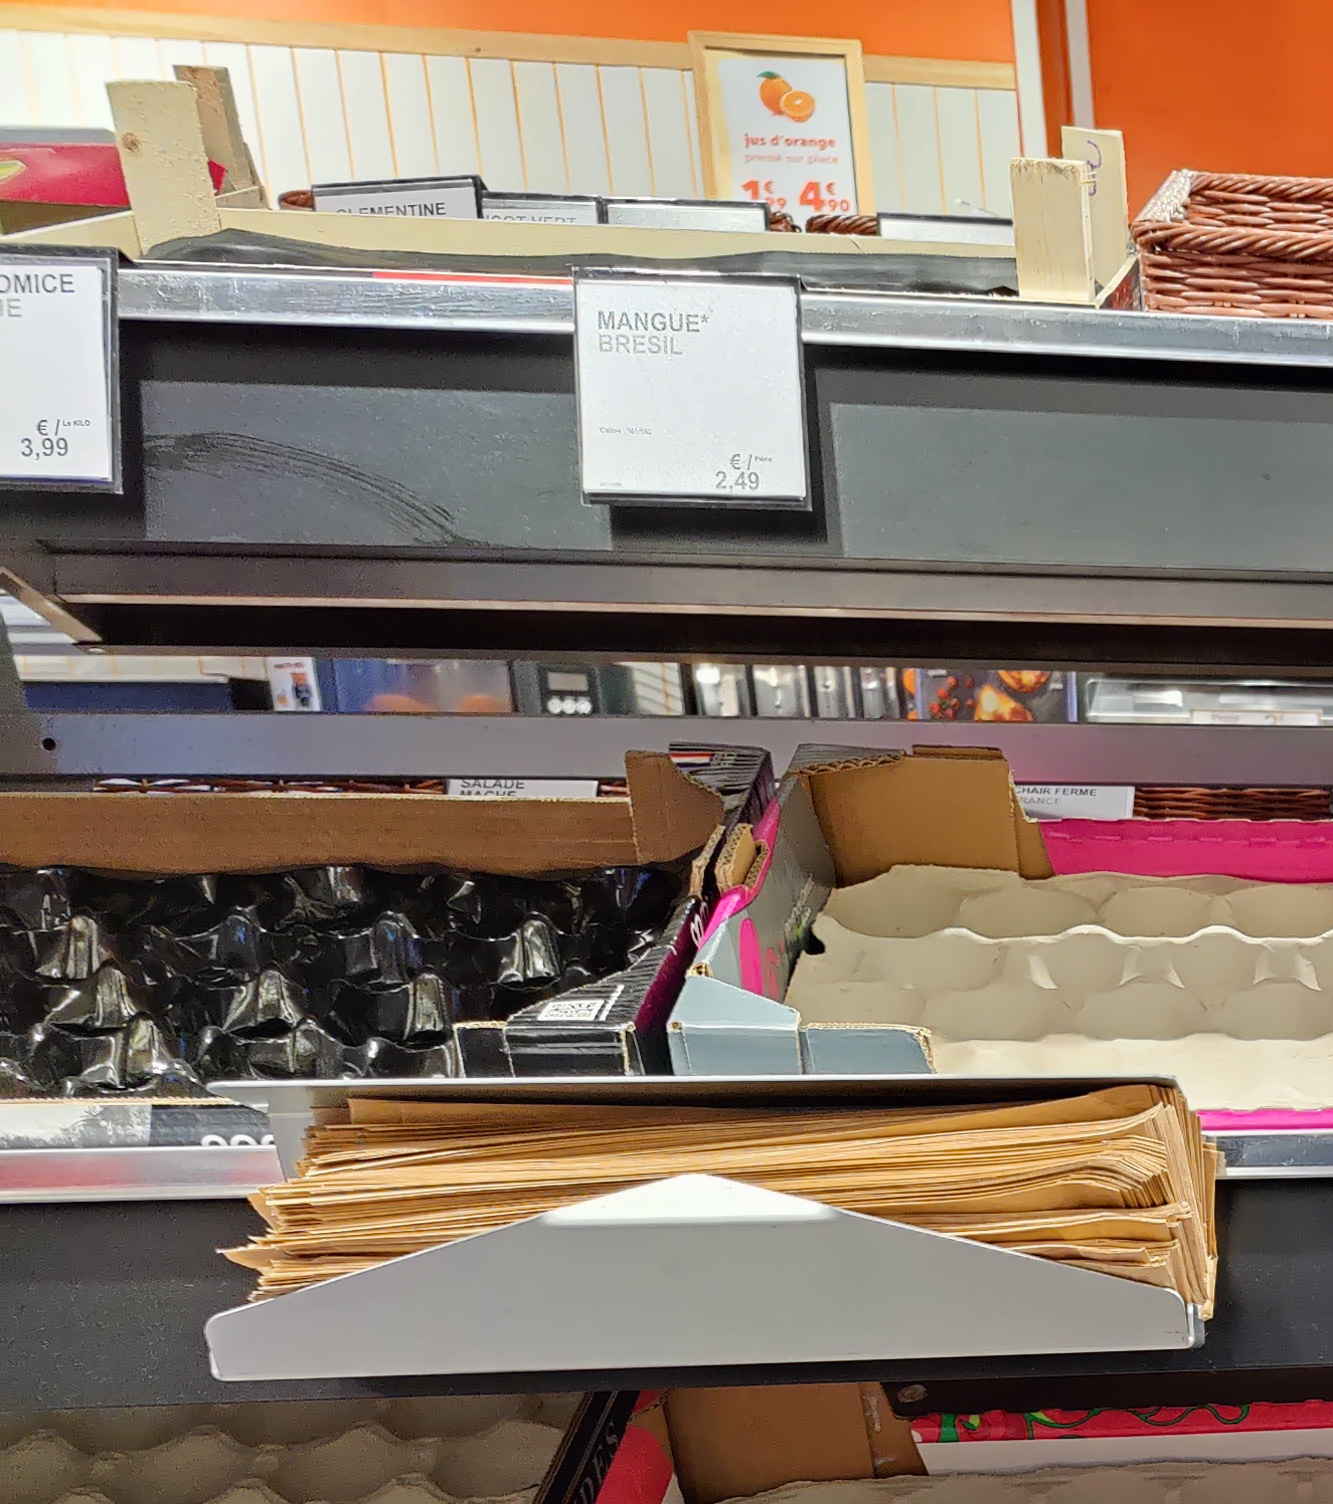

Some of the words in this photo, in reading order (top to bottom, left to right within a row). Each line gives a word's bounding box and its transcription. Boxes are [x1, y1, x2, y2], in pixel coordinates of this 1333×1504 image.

[744, 133, 767, 148] jus
[598, 334, 684, 356] BRESIL
[20, 437, 69, 461] 3,99
[715, 470, 761, 492] 2,49
[1055, 787, 1097, 797] FERME
[1020, 797, 1062, 806] RANCE
